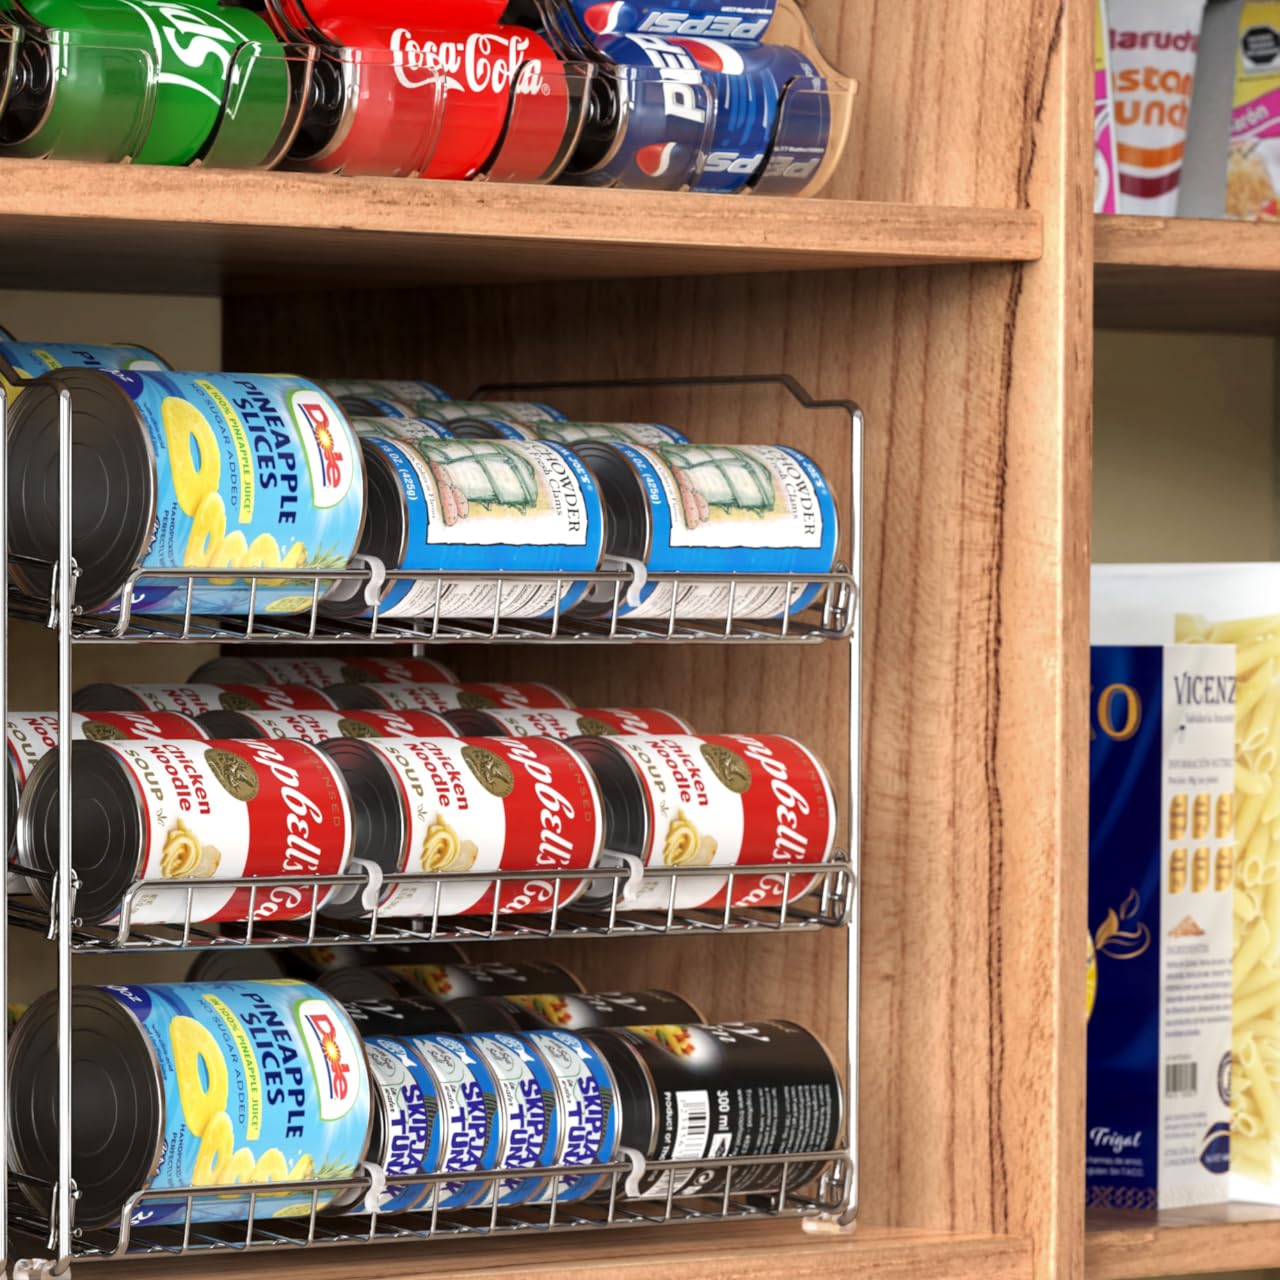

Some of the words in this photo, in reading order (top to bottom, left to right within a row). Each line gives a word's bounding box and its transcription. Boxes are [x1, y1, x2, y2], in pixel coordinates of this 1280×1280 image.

[637, 11, 770, 39] PEPSI
[390, 27, 544, 95] Coca-Cola
[206, 400, 230, 444] SUGAR
[228, 451, 238, 506] ADDED
[230, 418, 250, 475] PINEAPPLE
[233, 398, 278, 489] SLICES
[233, 380, 299, 524] PINEAPPLE
[302, 403, 341, 488] Dole
[533, 445, 580, 532] CHOWDER
[549, 480, 562, 516] Clams
[124, 748, 165, 802] SOUP
[143, 745, 192, 813] Noodle
[162, 743, 212, 815] Chicken
[384, 745, 424, 797] SOUP
[403, 742, 450, 807] Noodle
[418, 741, 469, 811] Chicken
[627, 744, 667, 793] SOUP
[644, 740, 692, 803] Noodle
[660, 738, 709, 806] Chicken
[236, 740, 324, 874] mpbell's
[211, 1013, 238, 1064] SUGAR
[235, 1070, 245, 1125] ADDED
[219, 1006, 241, 1032] 100%
[237, 1035, 257, 1094] PINEAPPLE
[240, 1013, 284, 1106] SLICES
[241, 992, 306, 1139] PINEAPPLE
[308, 1015, 351, 1101] Dole
[402, 1084, 427, 1176] SKIPJA
[717, 1090, 731, 1112] 300
[719, 1116, 729, 1131] ml
[1089, 1126, 1142, 1153] Trigal
